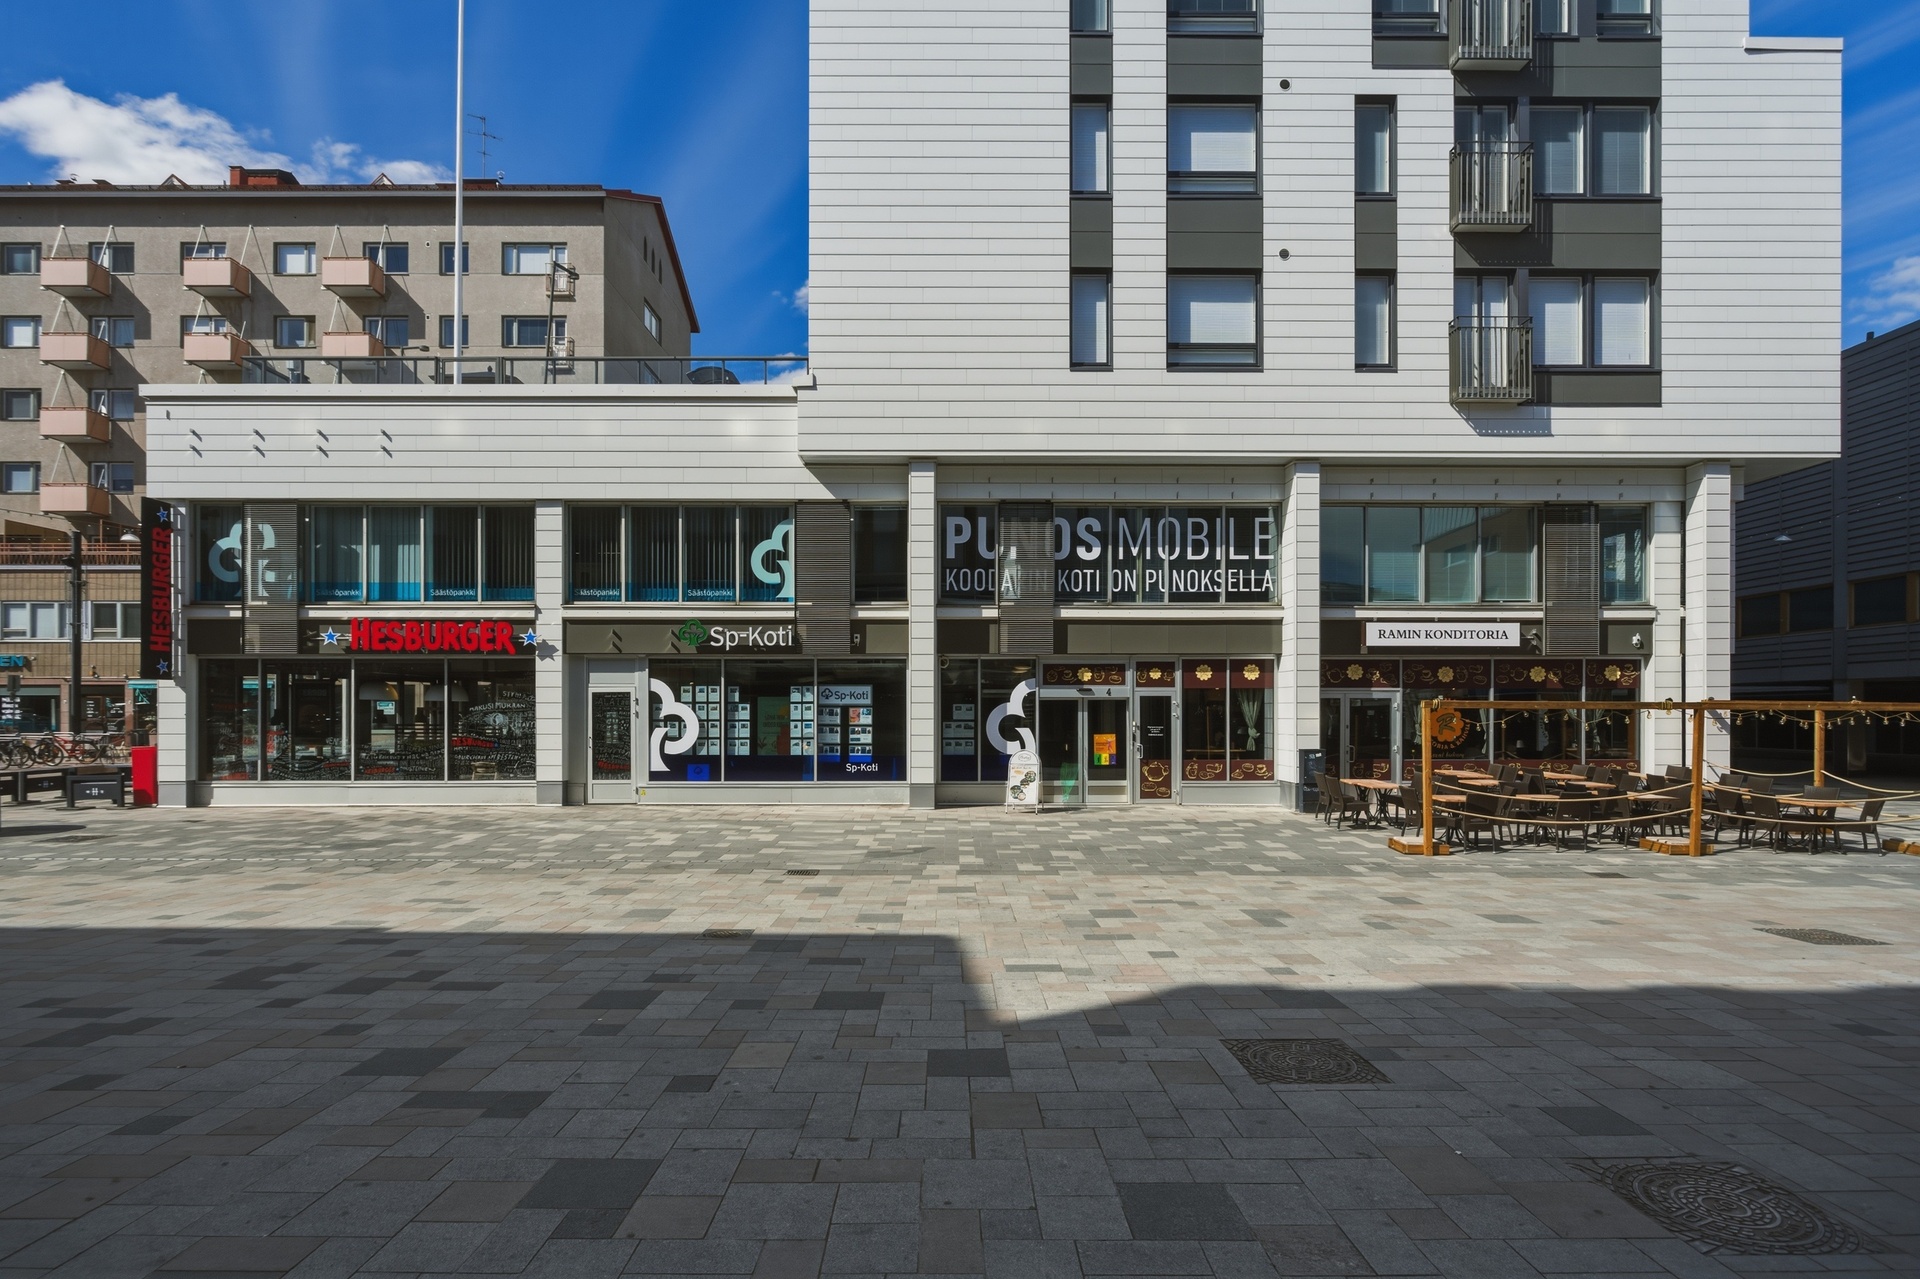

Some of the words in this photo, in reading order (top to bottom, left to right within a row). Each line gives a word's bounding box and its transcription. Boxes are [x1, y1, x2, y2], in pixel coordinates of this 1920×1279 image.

[1118, 517, 1275, 561] MOBILE
[149, 526, 174, 652] HESBURGER
[1058, 569, 1100, 593] KOTI
[1112, 569, 1137, 592] ON
[1145, 569, 1274, 592] PUNOKSELLA
[430, 588, 476, 597] Säästöpankki
[688, 588, 733, 597] Säästöpankki
[350, 617, 516, 655] HESBURGER
[710, 625, 792, 651] Sp-Koti
[1378, 629, 1421, 640] RAMIN
[1424, 629, 1509, 640] KONDITORIA
[834, 690, 869, 702] Sp-Koti
[845, 763, 879, 773] Sp-Koti
